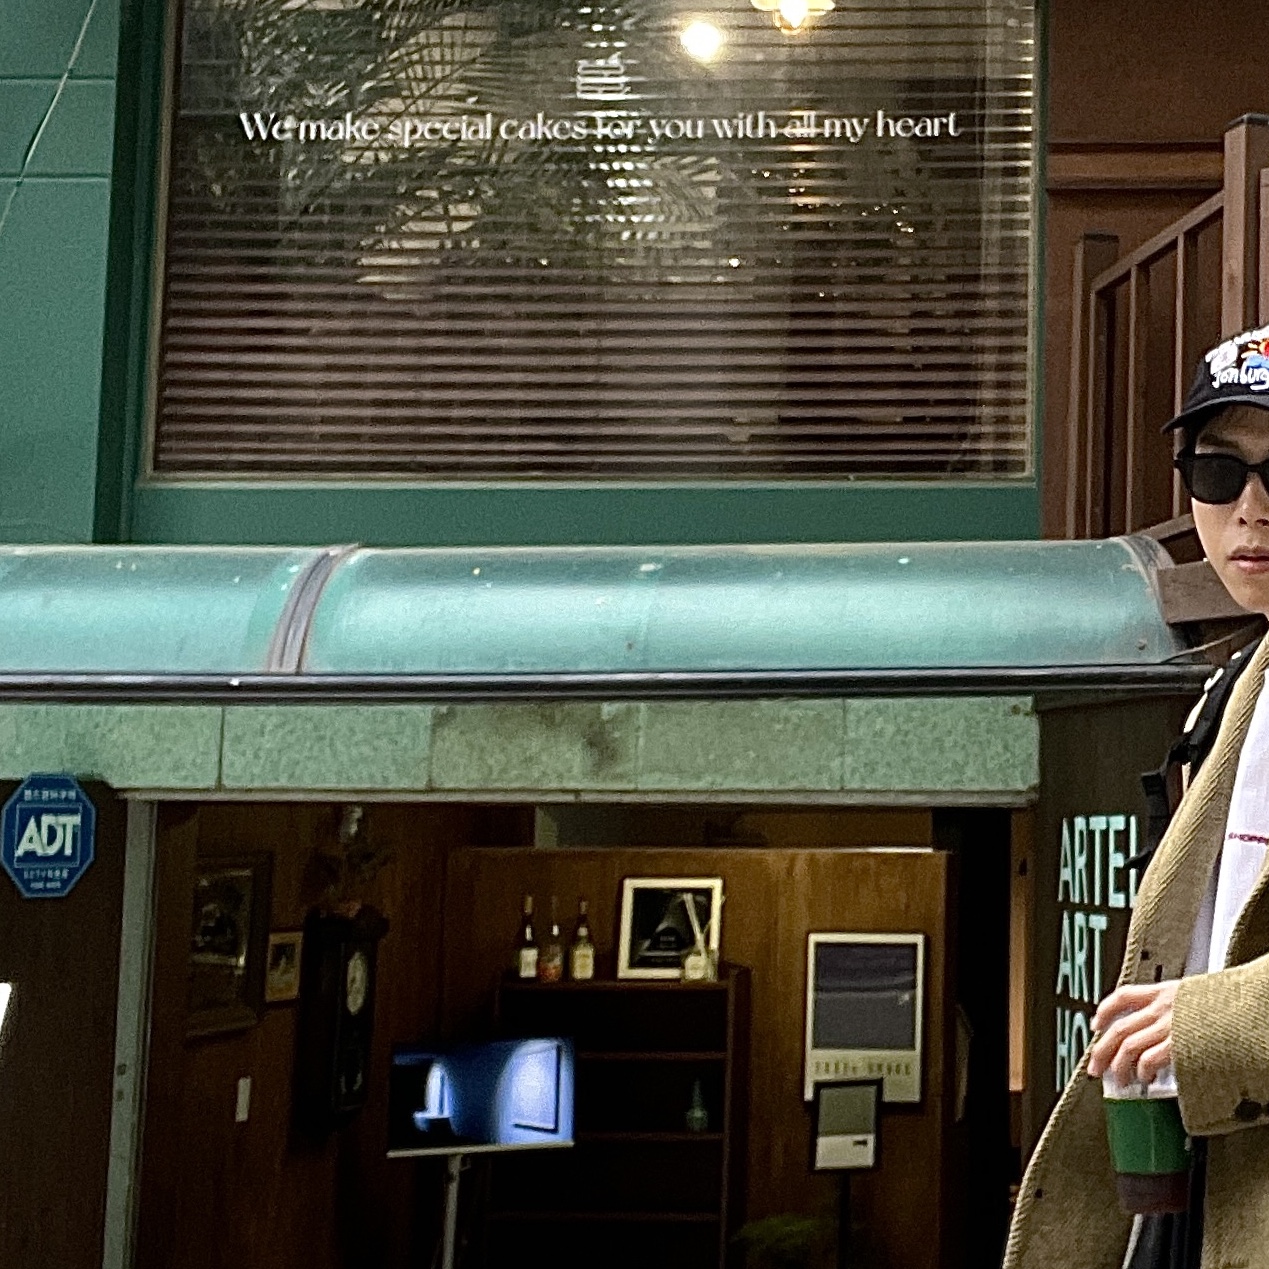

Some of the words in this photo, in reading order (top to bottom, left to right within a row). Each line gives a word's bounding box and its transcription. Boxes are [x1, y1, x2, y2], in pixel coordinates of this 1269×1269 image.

[239, 111, 292, 141] We
[299, 110, 380, 141] make
[389, 112, 492, 149] special
[500, 110, 589, 141] cakes
[596, 110, 641, 140] for
[648, 117, 704, 145] you
[711, 111, 777, 139] with
[785, 110, 817, 139] all
[824, 117, 868, 144] my
[876, 109, 961, 139] heart
[14, 812, 81, 857] ADT
[1055, 910, 1108, 1005] ART
